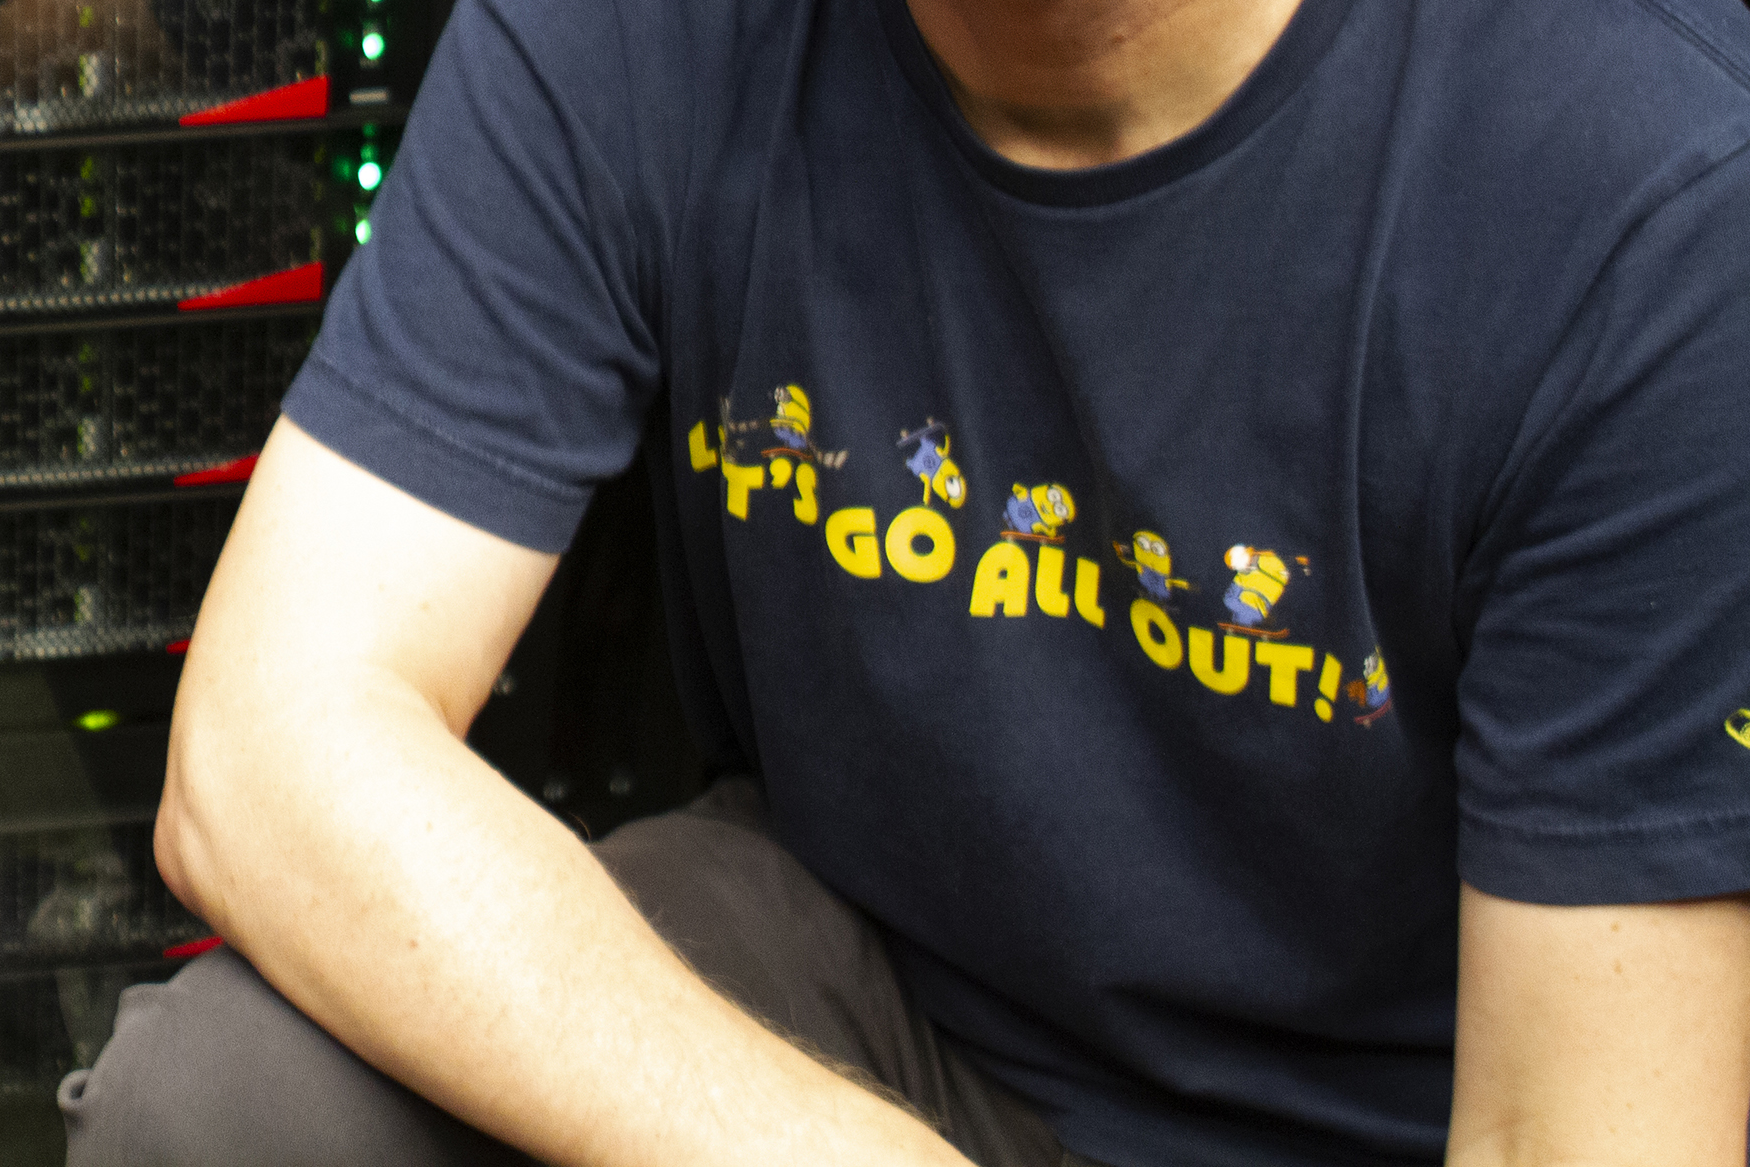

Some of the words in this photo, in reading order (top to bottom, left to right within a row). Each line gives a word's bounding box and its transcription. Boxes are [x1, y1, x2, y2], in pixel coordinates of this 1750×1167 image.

[688, 419, 818, 526] LT'S
[825, 506, 956, 583] GO
[969, 540, 1106, 629] ALL
[1130, 597, 1343, 723] OUT!
